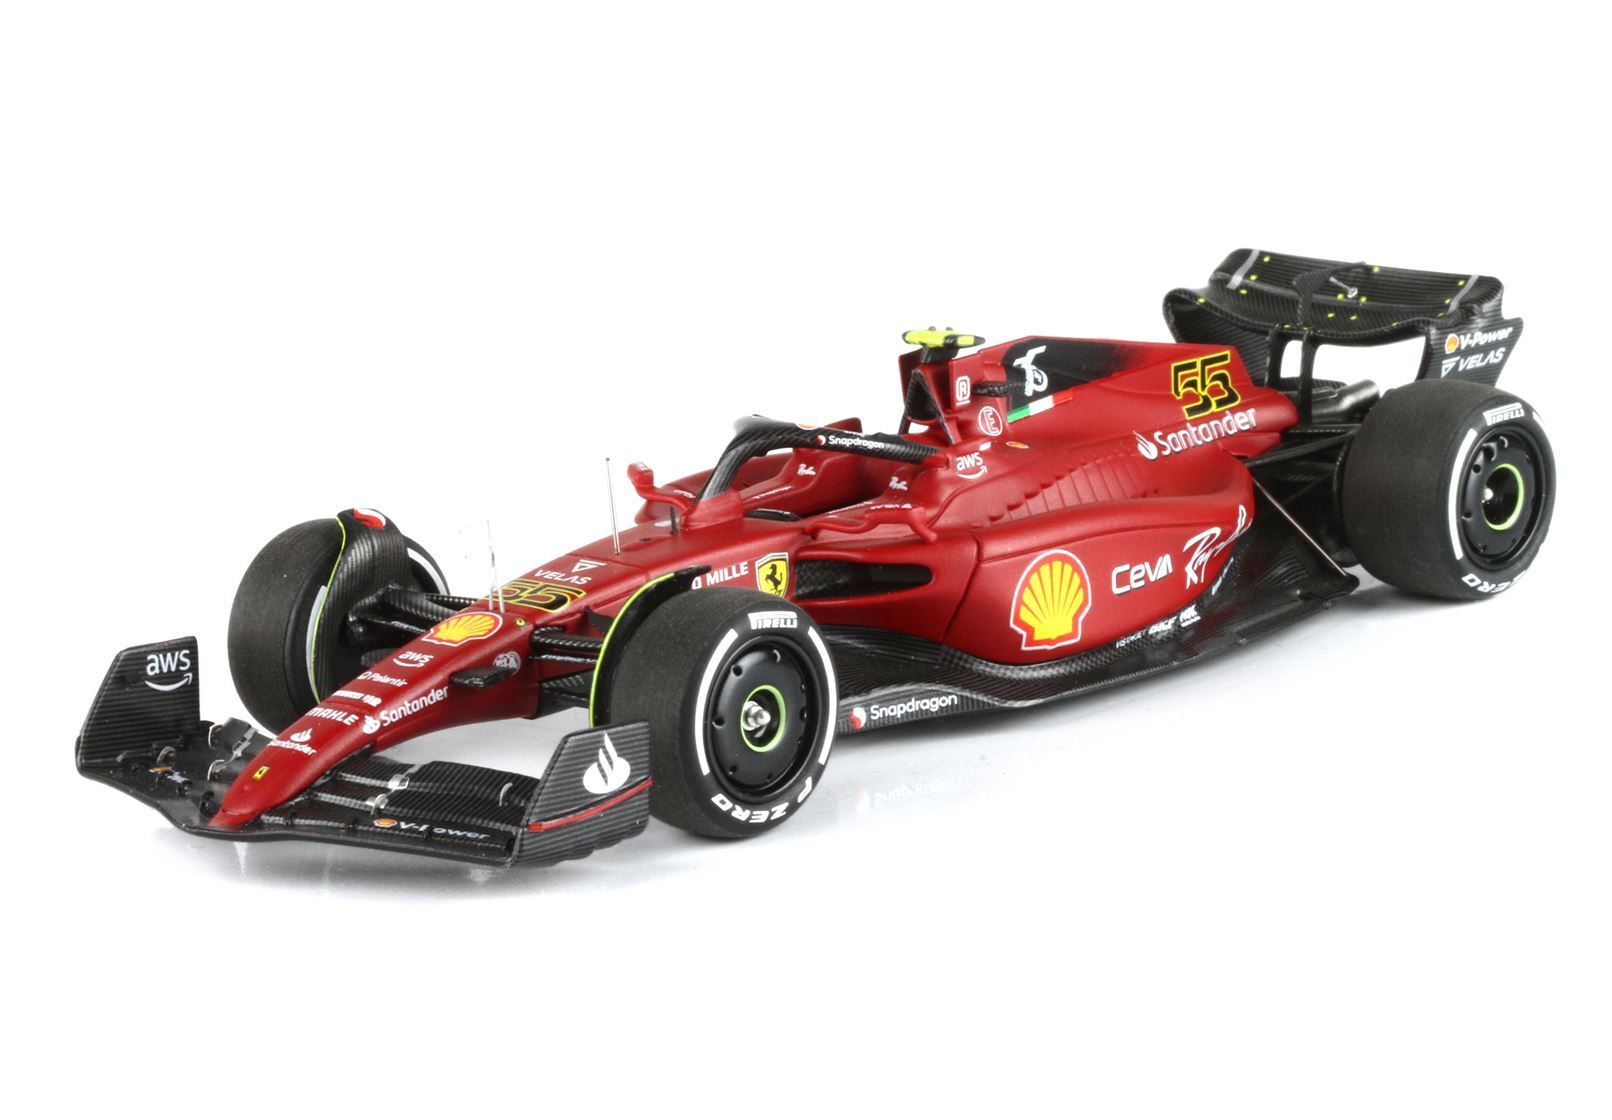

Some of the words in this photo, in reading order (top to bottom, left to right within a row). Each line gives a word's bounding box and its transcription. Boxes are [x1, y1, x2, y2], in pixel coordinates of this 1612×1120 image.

[1460, 327, 1513, 350] V-Power
[1458, 347, 1506, 372] VELAS
[1171, 350, 1241, 420] 55
[1483, 402, 1525, 426] PIRELLI
[828, 435, 885, 450] Snapdragon
[1153, 407, 1259, 457] Santander
[956, 452, 984, 471] aws
[534, 569, 592, 585] VELAS
[706, 561, 749, 587] MILLE
[482, 578, 587, 613] 55
[747, 611, 798, 630] PIRELLI
[146, 649, 191, 676] aws
[399, 651, 435, 664] aws
[304, 706, 360, 726] MAHLE
[379, 686, 449, 727] Santander
[870, 694, 958, 720] Snapdragon
[797, 776, 813, 803] P
[711, 793, 790, 823] ZERO
